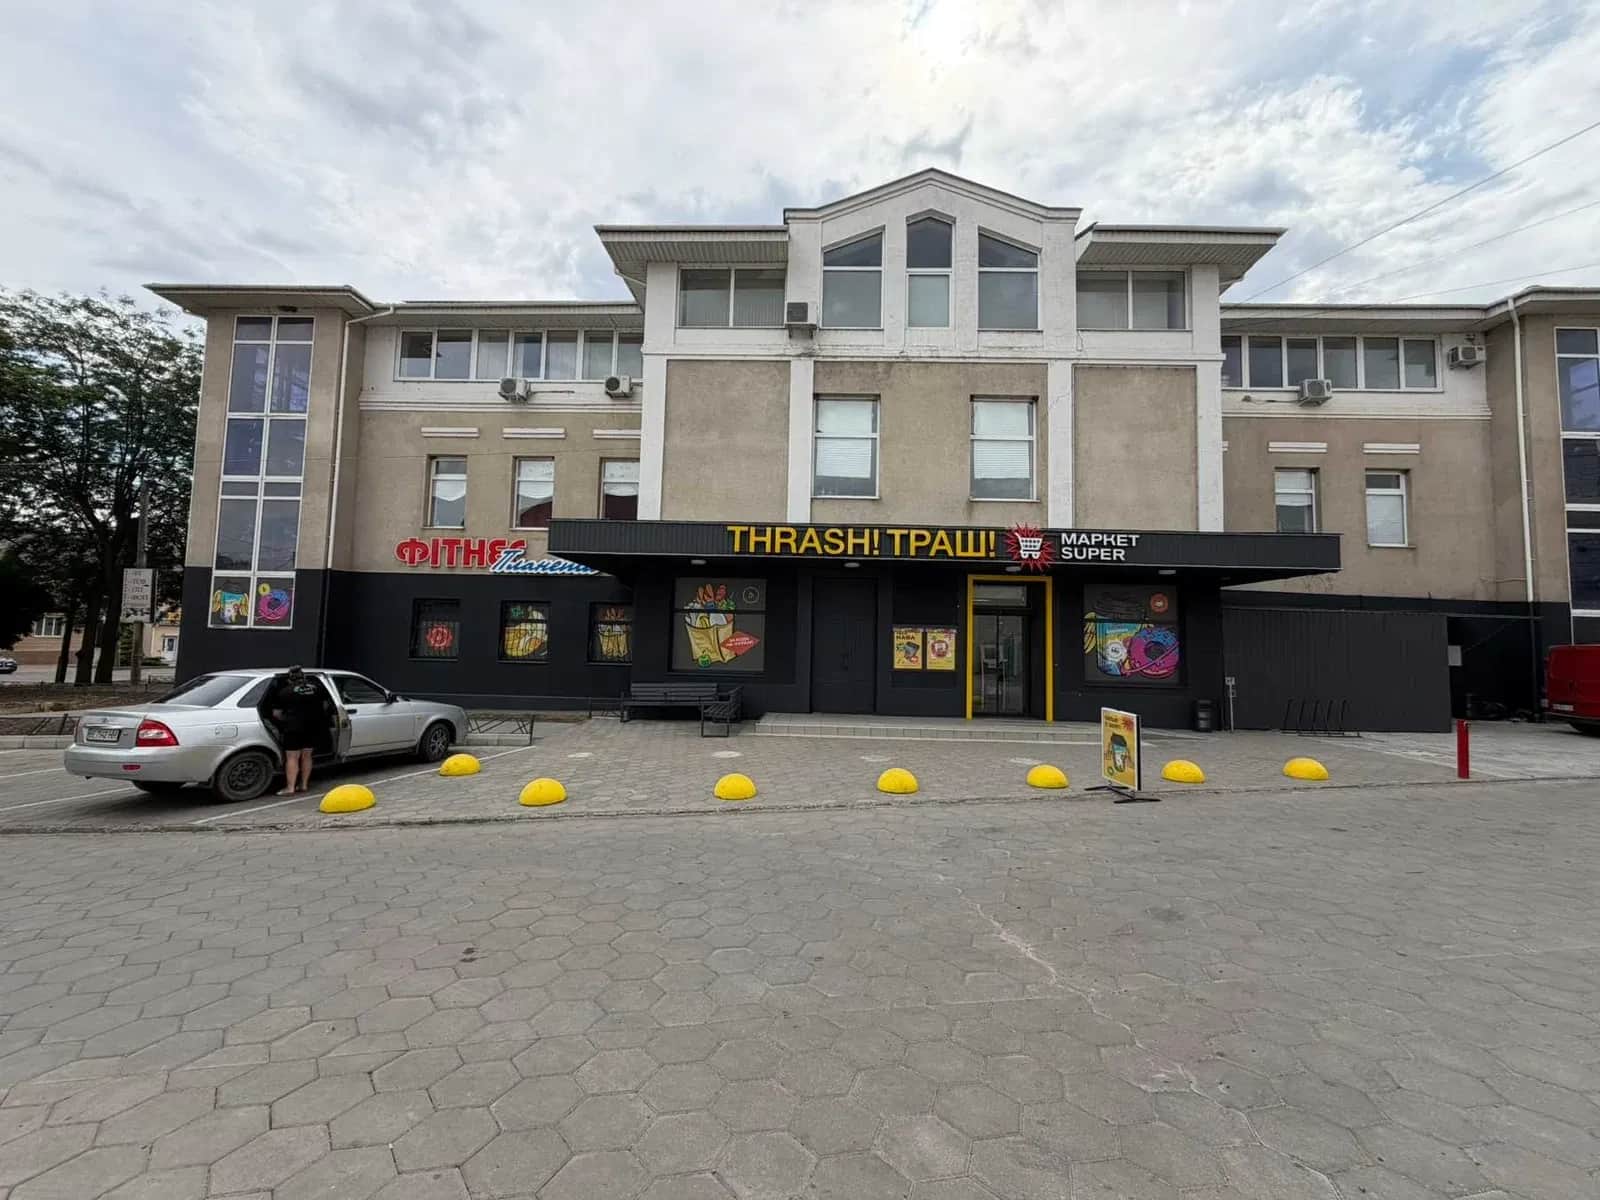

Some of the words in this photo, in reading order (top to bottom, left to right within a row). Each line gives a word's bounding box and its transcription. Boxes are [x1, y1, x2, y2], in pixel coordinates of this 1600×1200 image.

[727, 525, 880, 555] THRASH!
[886, 528, 996, 557] ТРАШ!
[1061, 532, 1140, 547] МАРКЕТ
[1061, 546, 1126, 561] SUPER
